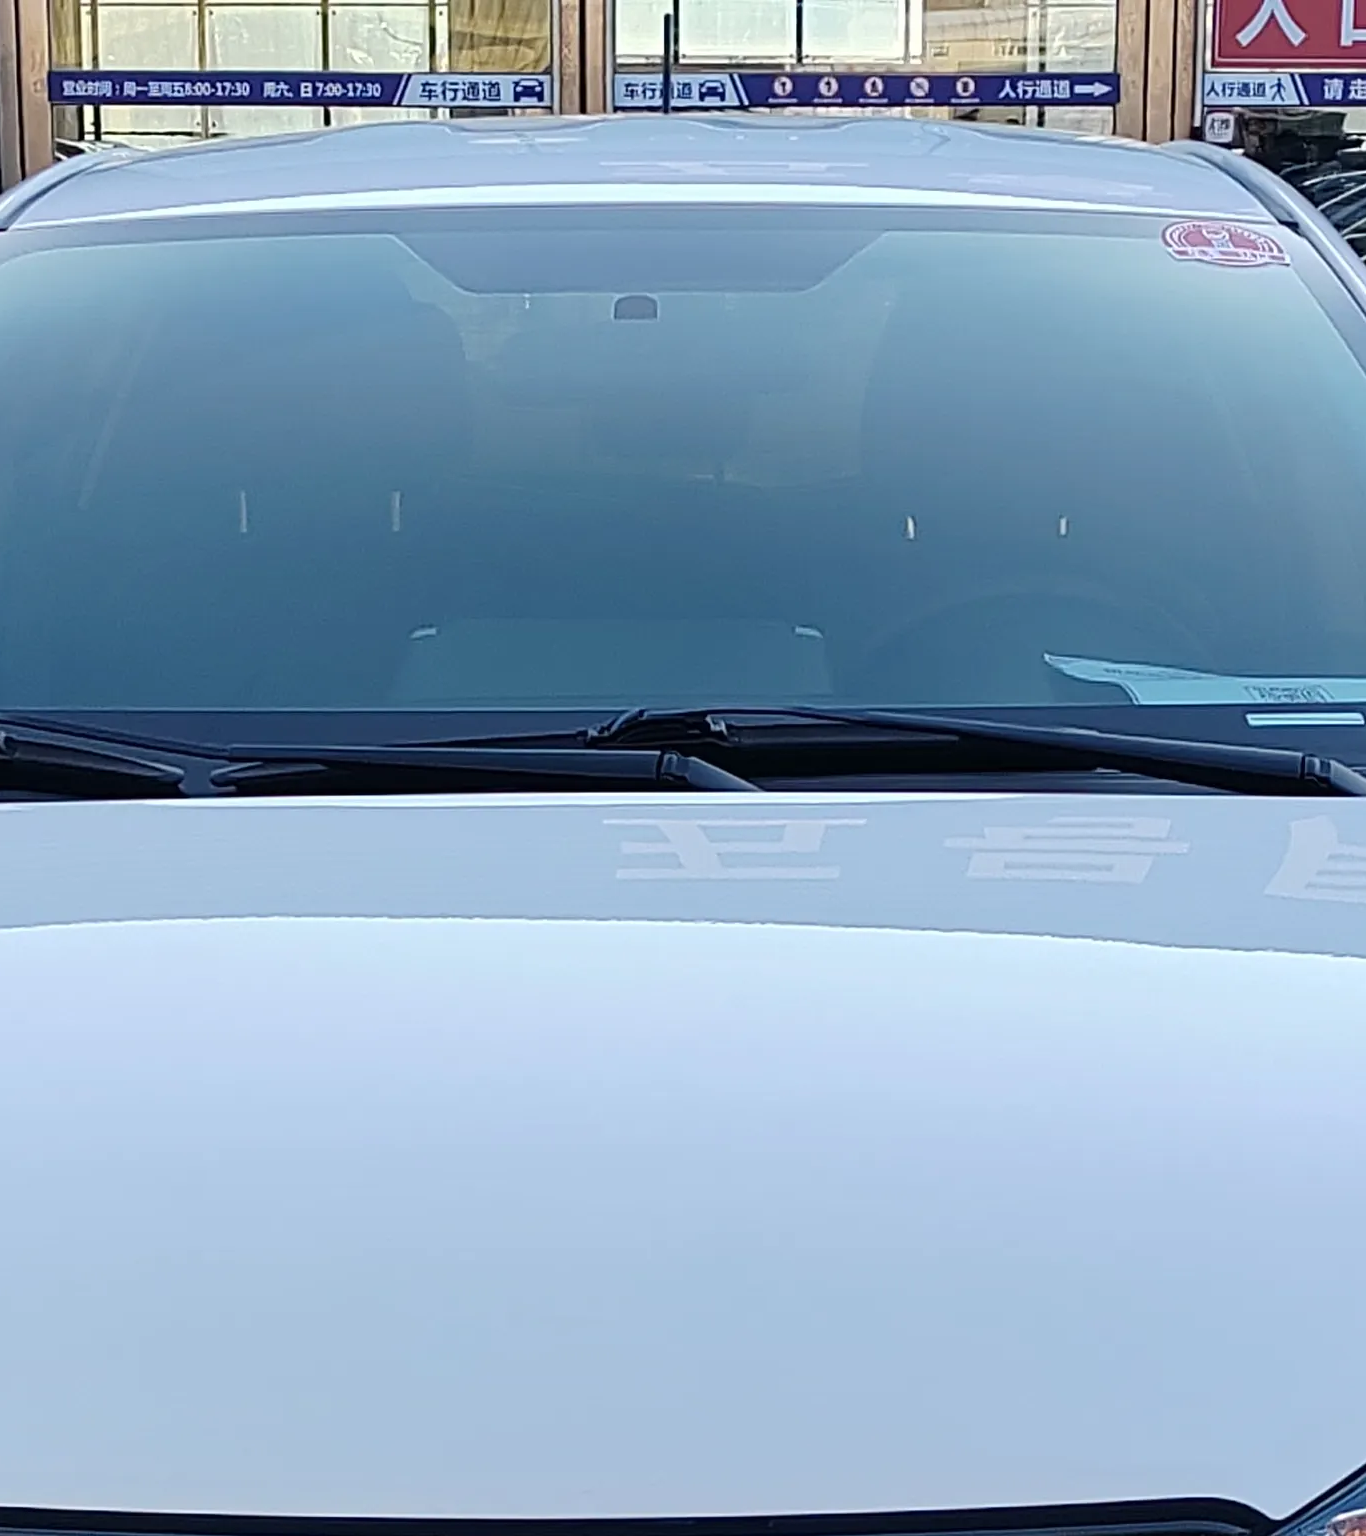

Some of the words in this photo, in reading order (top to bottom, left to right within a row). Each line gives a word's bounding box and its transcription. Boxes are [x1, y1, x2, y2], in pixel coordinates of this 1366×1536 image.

[419, 81, 501, 101] 车行通道
[999, 79, 1070, 99] 人行通道
[1206, 80, 1266, 98] 人行通道
